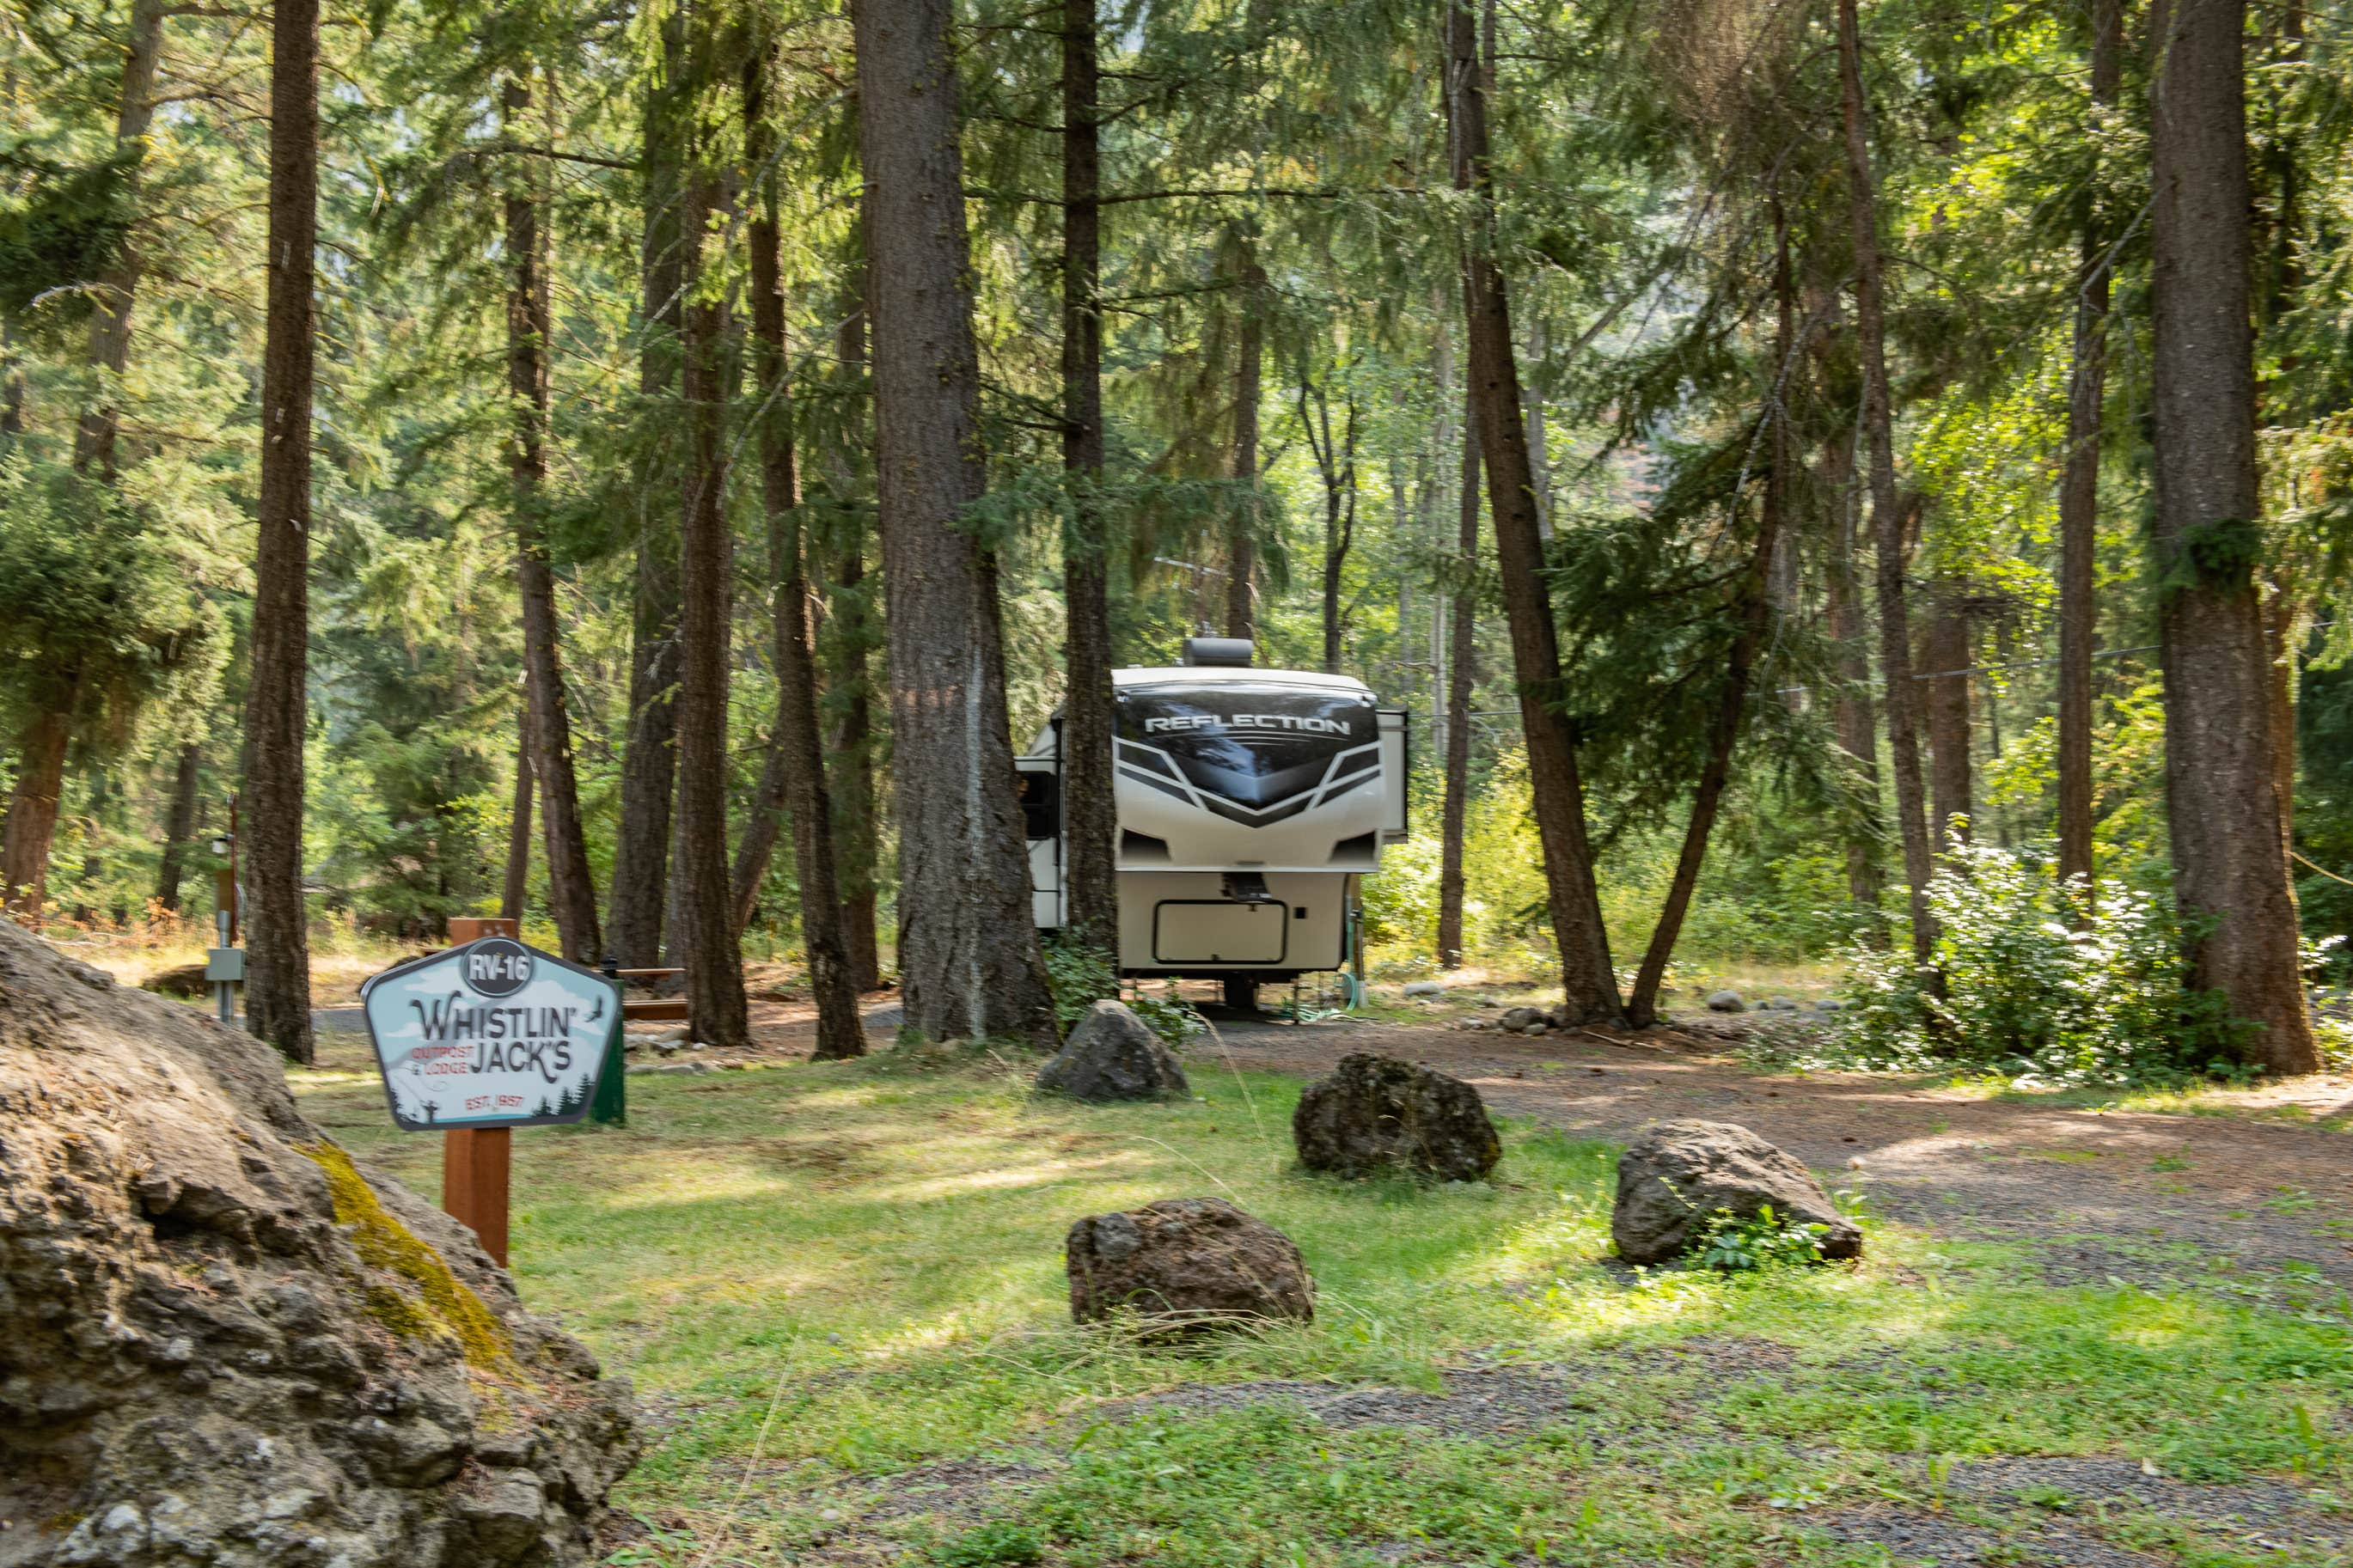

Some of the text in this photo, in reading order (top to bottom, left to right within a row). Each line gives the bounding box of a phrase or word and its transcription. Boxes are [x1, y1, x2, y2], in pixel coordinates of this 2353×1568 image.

[1145, 714, 1351, 735] REFLECTION
[468, 955, 529, 980] RV-16
[412, 1046, 474, 1059] OUTPOST
[471, 1040, 571, 1083] JACK'S
[425, 1062, 468, 1075] LODGE
